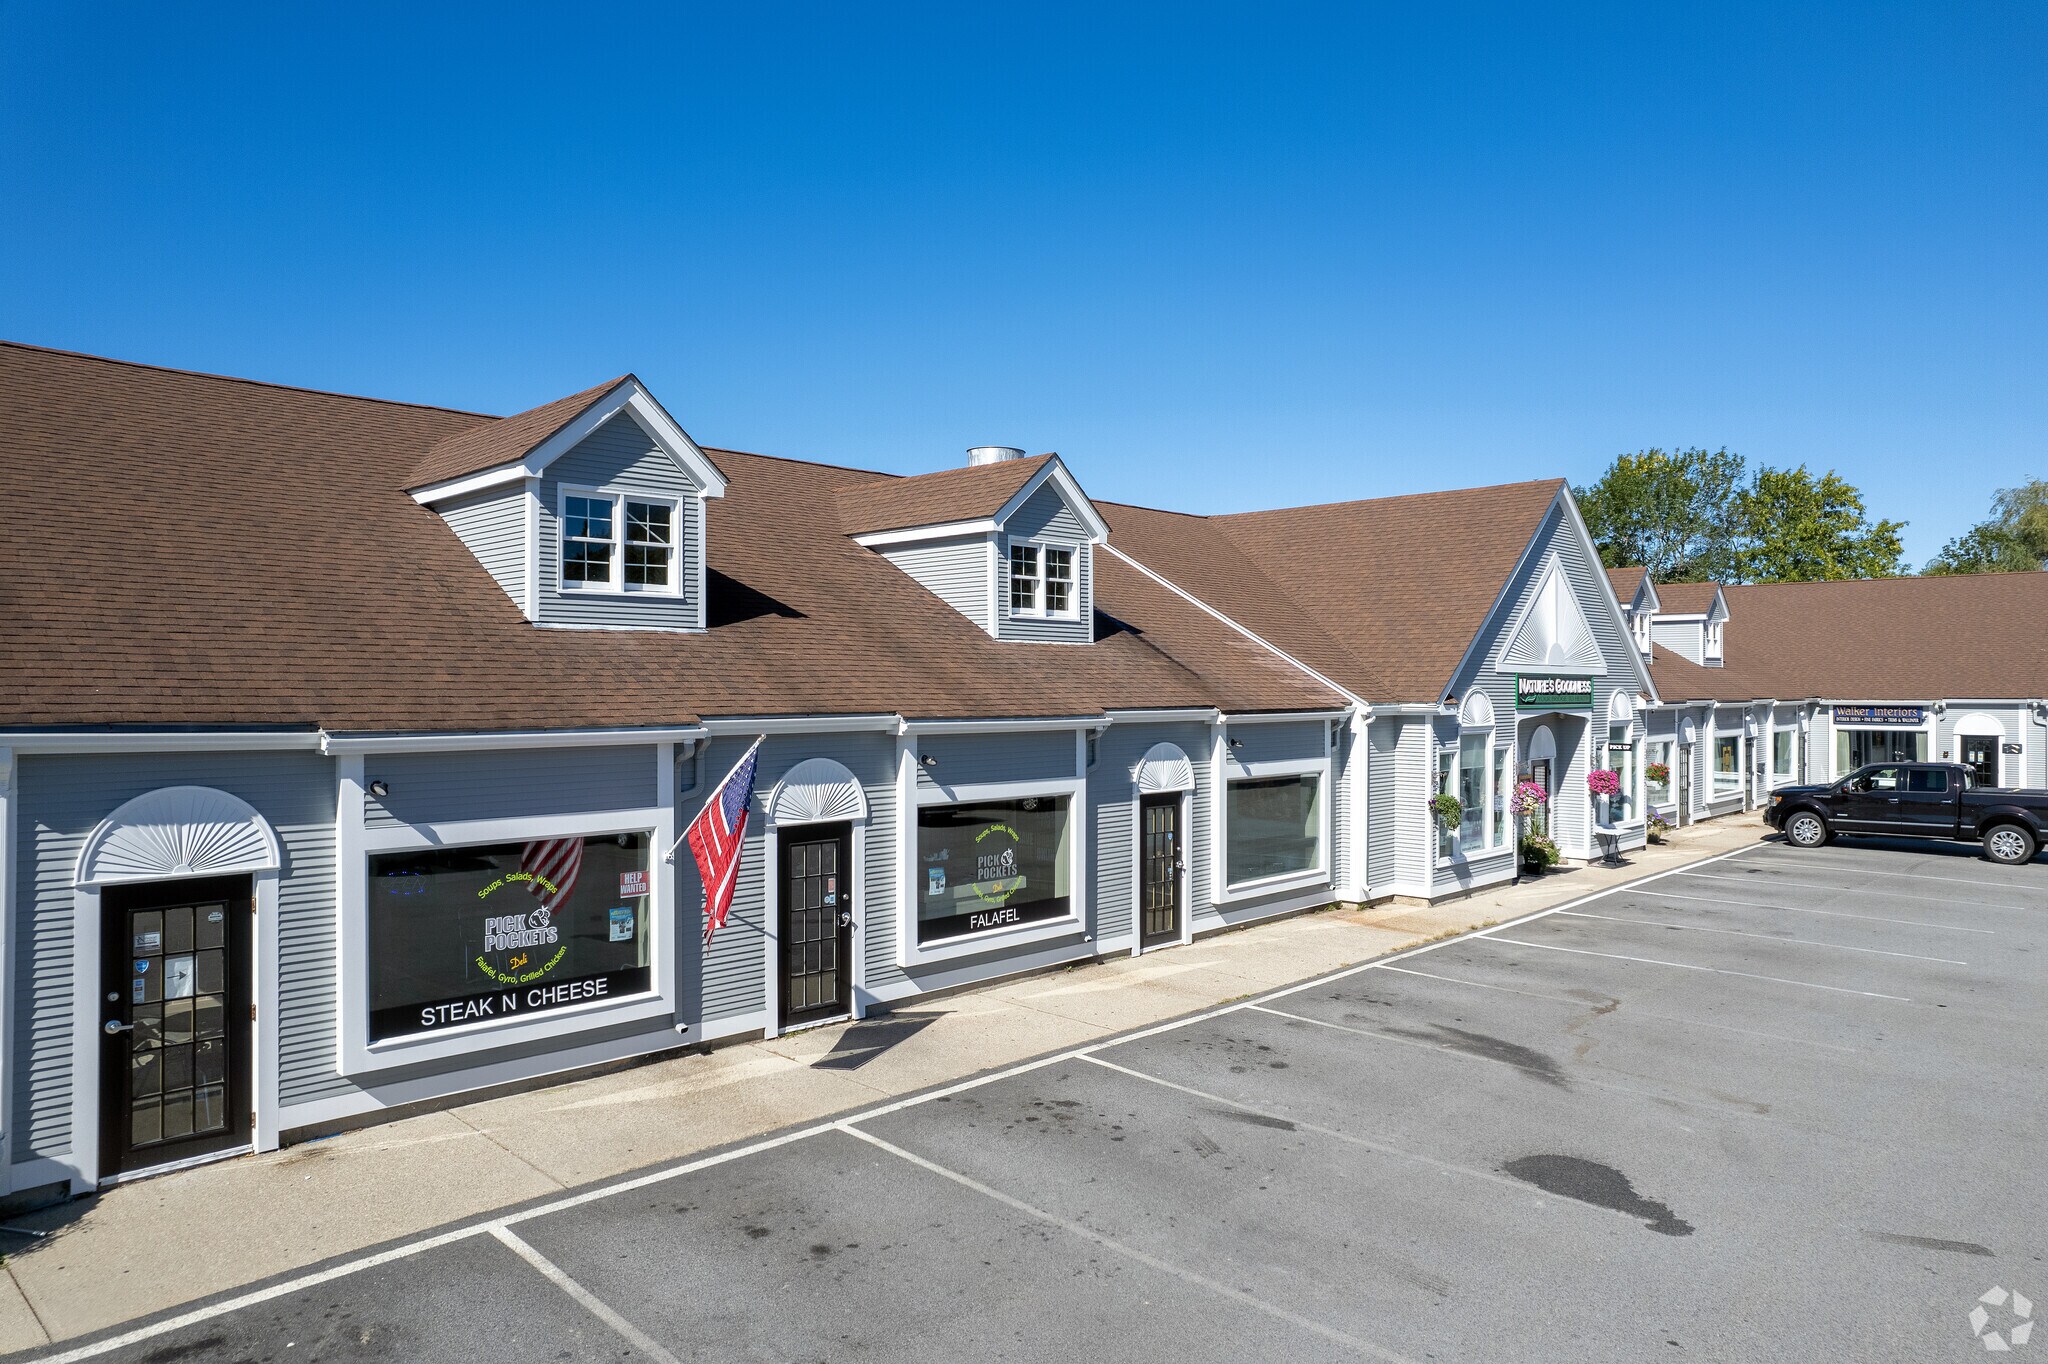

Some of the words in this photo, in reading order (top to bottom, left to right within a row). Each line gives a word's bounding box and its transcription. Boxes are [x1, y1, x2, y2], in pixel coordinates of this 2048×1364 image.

[1555, 679, 1592, 694] GOODNESS
[1836, 707, 1870, 716] Walker
[1874, 707, 1918, 716] Interiors
[978, 855, 1000, 868] PICK
[624, 873, 643, 885] HELP
[978, 864, 1018, 880] POCKETS
[505, 872, 534, 883] Salads,
[537, 875, 558, 894] Wraps
[620, 883, 647, 894] WANTED
[485, 914, 527, 935] PICK
[970, 908, 1020, 929] FALAFEL
[484, 926, 558, 953] POCKETS
[475, 955, 497, 980] Falafel,
[498, 973, 518, 985] Gyro,
[520, 968, 544, 983] Grilled
[544, 945, 567, 972] Chicken
[509, 952, 528, 970] Deli
[421, 997, 493, 1026] STEAK
[502, 993, 516, 1012] N
[527, 978, 608, 1007] CHEESE
